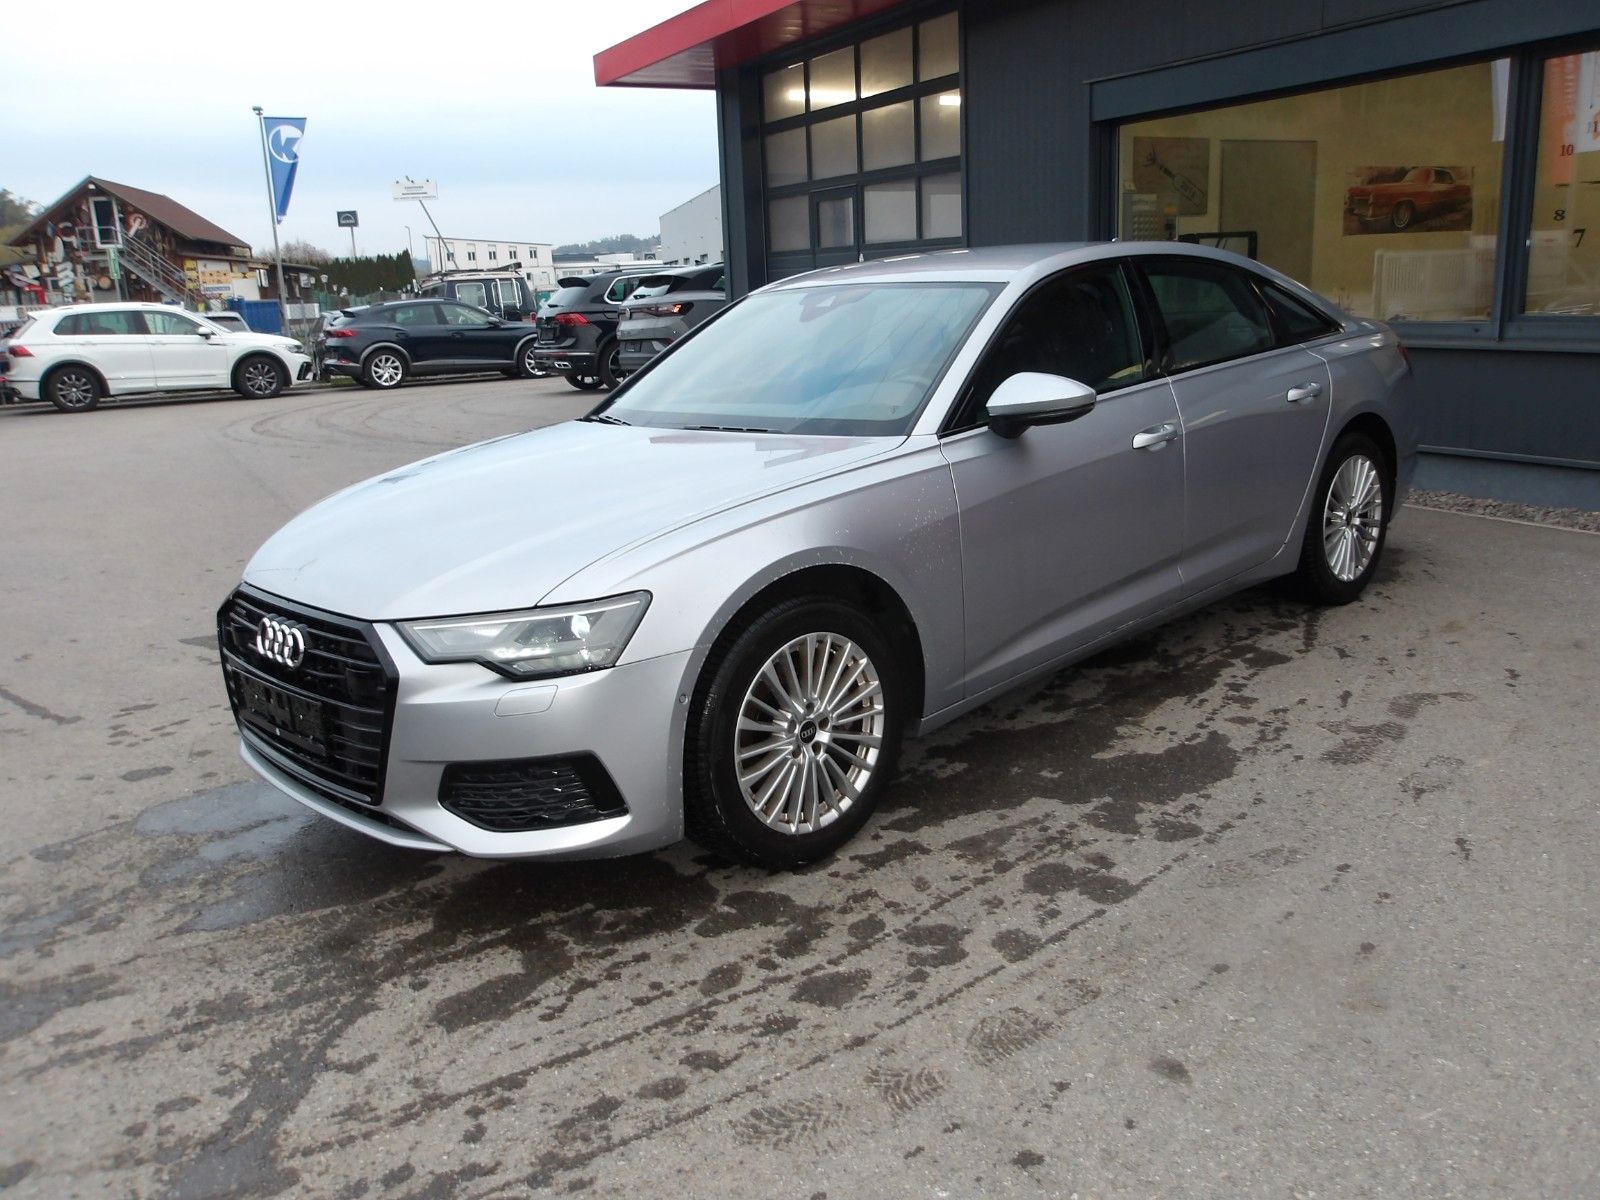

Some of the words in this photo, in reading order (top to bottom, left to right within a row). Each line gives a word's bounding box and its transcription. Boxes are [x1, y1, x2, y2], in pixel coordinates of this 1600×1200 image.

[1560, 144, 1574, 157] 10
[1553, 209, 1565, 221] 8
[1573, 229, 1586, 248] 7
